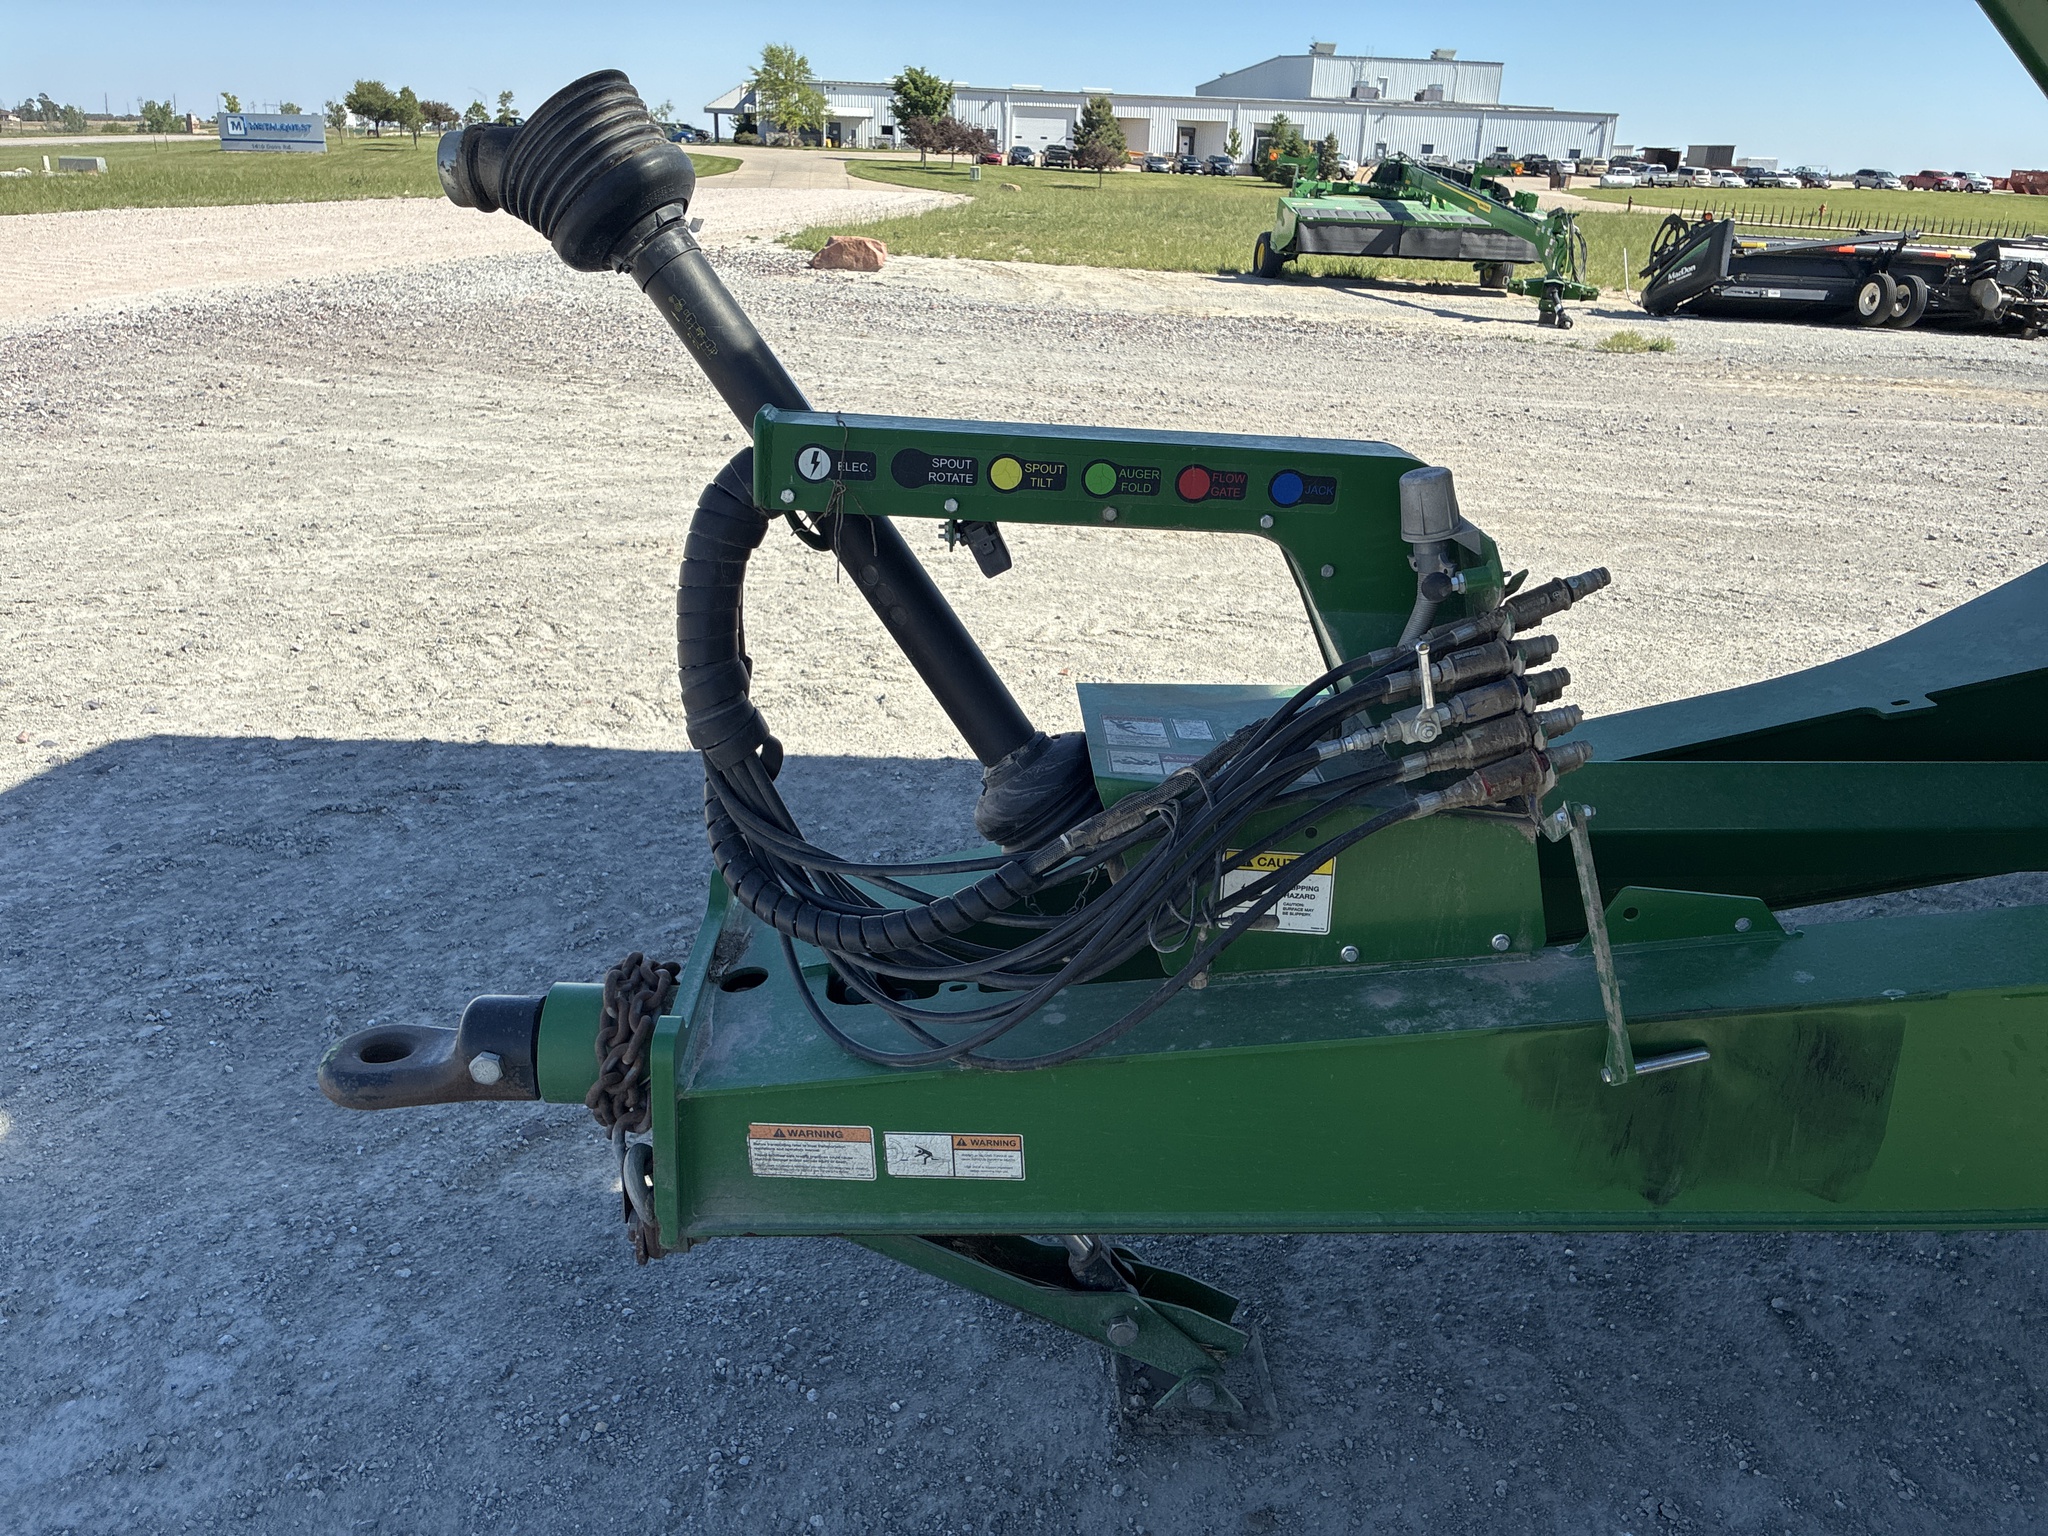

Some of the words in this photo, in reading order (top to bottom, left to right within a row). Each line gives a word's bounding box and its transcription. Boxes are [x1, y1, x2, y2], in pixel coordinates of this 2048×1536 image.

[1667, 264, 1695, 281] MacDon
[837, 461, 871, 473] ELEC.
[931, 458, 973, 470] SPOUT
[1024, 463, 1065, 475] SPOUT
[928, 472, 973, 484] ROTATE
[1118, 468, 1160, 480] AUGER
[1212, 473, 1246, 484] FLOW
[1030, 477, 1054, 488] TILT
[1121, 482, 1152, 493] FOLD
[1210, 487, 1241, 498] GATE
[1305, 485, 1335, 496] JACK
[787, 1129, 844, 1139] WARNING
[970, 1139, 1017, 1147] WARNING
